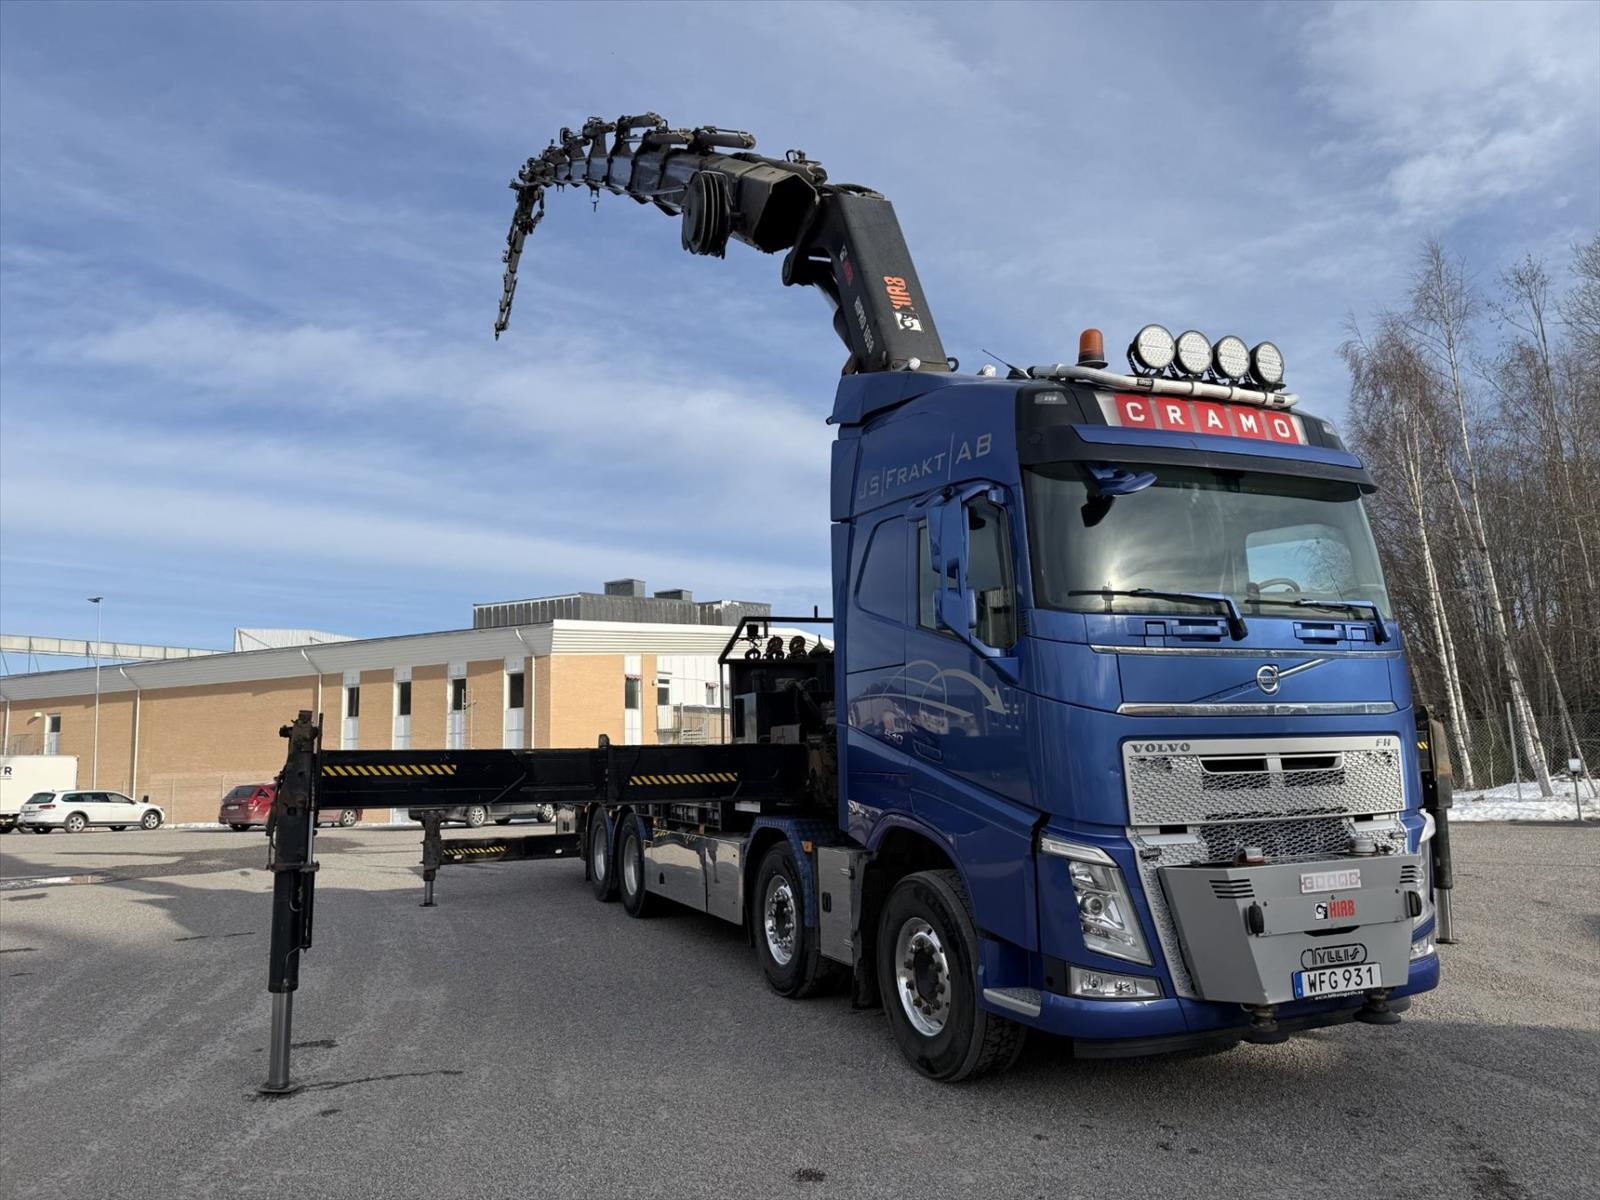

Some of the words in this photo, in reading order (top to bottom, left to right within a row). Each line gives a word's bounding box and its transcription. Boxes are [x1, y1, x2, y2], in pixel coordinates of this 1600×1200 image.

[1125, 402, 1290, 438] CRAMO
[955, 432, 993, 465] AB
[1130, 743, 1191, 753] VOLVO
[1329, 900, 1355, 918] HIAB
[1311, 947, 1361, 966] TYLLIS
[1308, 971, 1338, 993] WFG
[1342, 966, 1374, 988] 931
